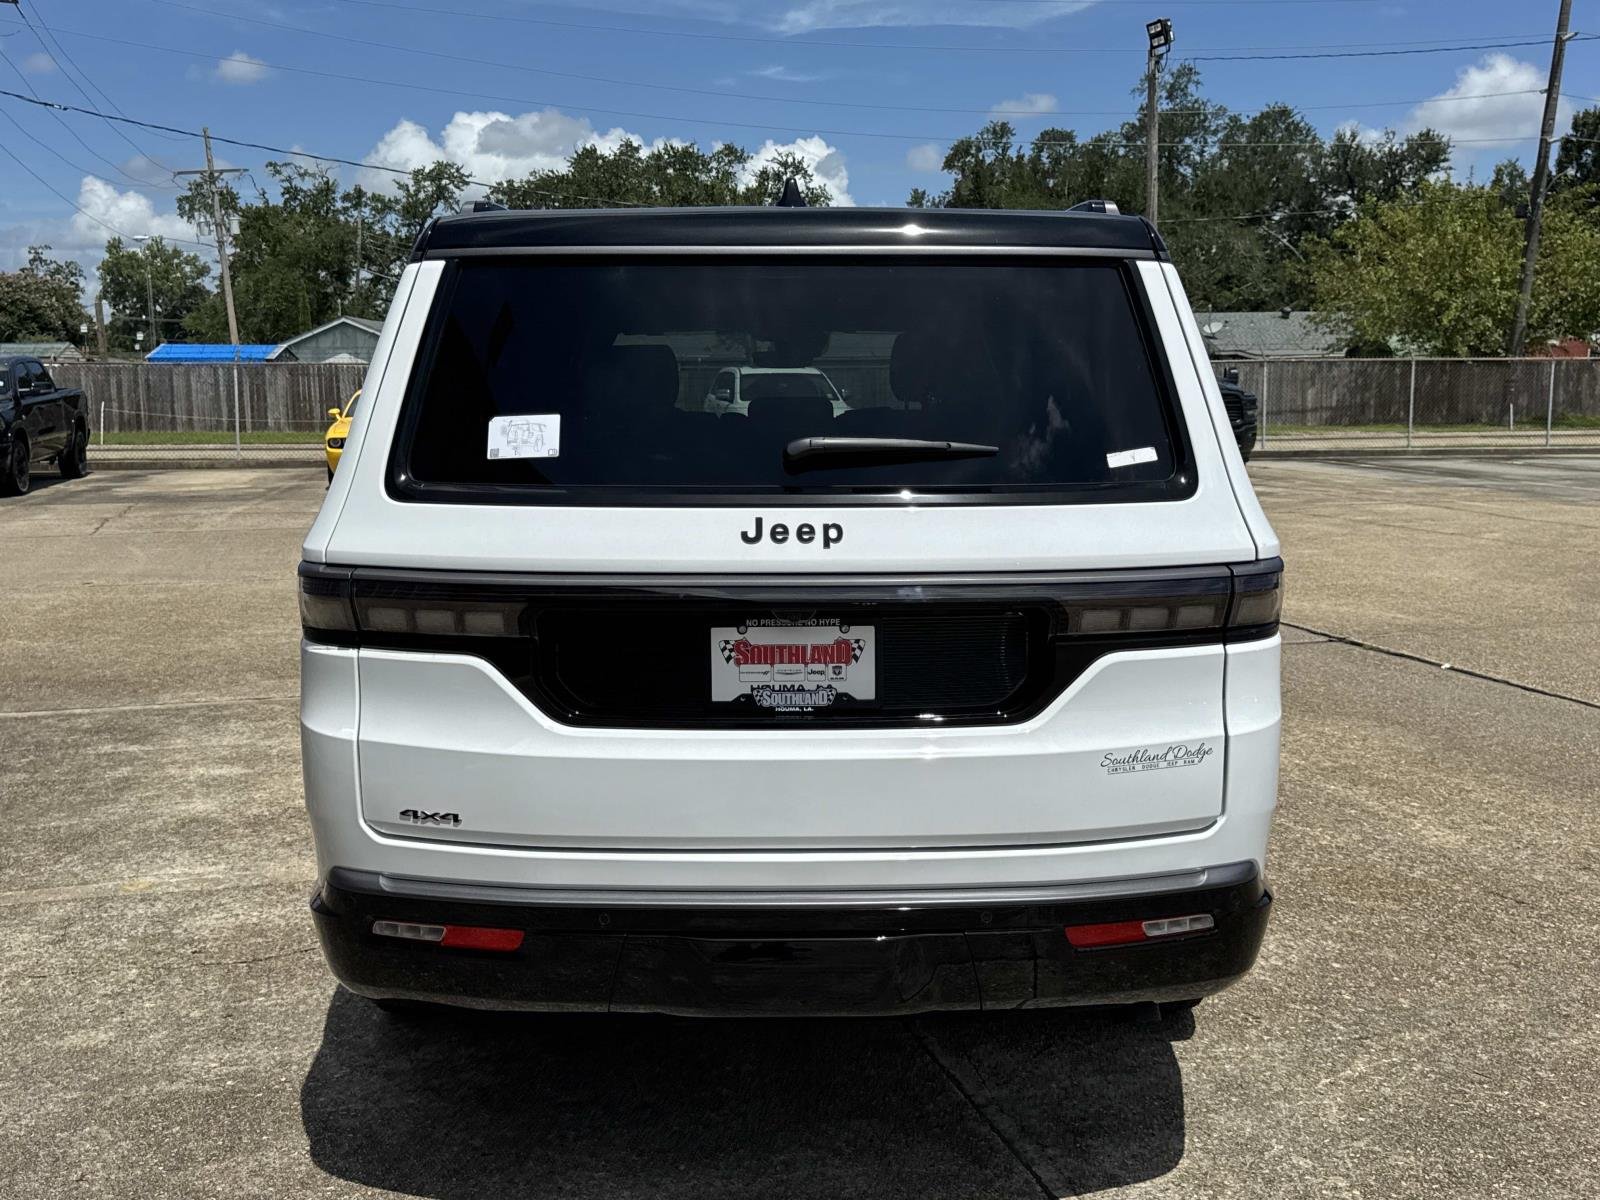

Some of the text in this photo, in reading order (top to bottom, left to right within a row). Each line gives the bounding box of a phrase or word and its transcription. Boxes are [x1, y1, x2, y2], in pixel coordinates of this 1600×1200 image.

[740, 516, 844, 549] Jeep
[746, 619, 759, 628] NO
[819, 618, 841, 627] HYPE
[734, 640, 852, 666] SOUTHLAND
[807, 669, 826, 677] Jeep
[762, 691, 828, 705] SOUTHLAND
[1100, 742, 1214, 768] Southland Dodge
